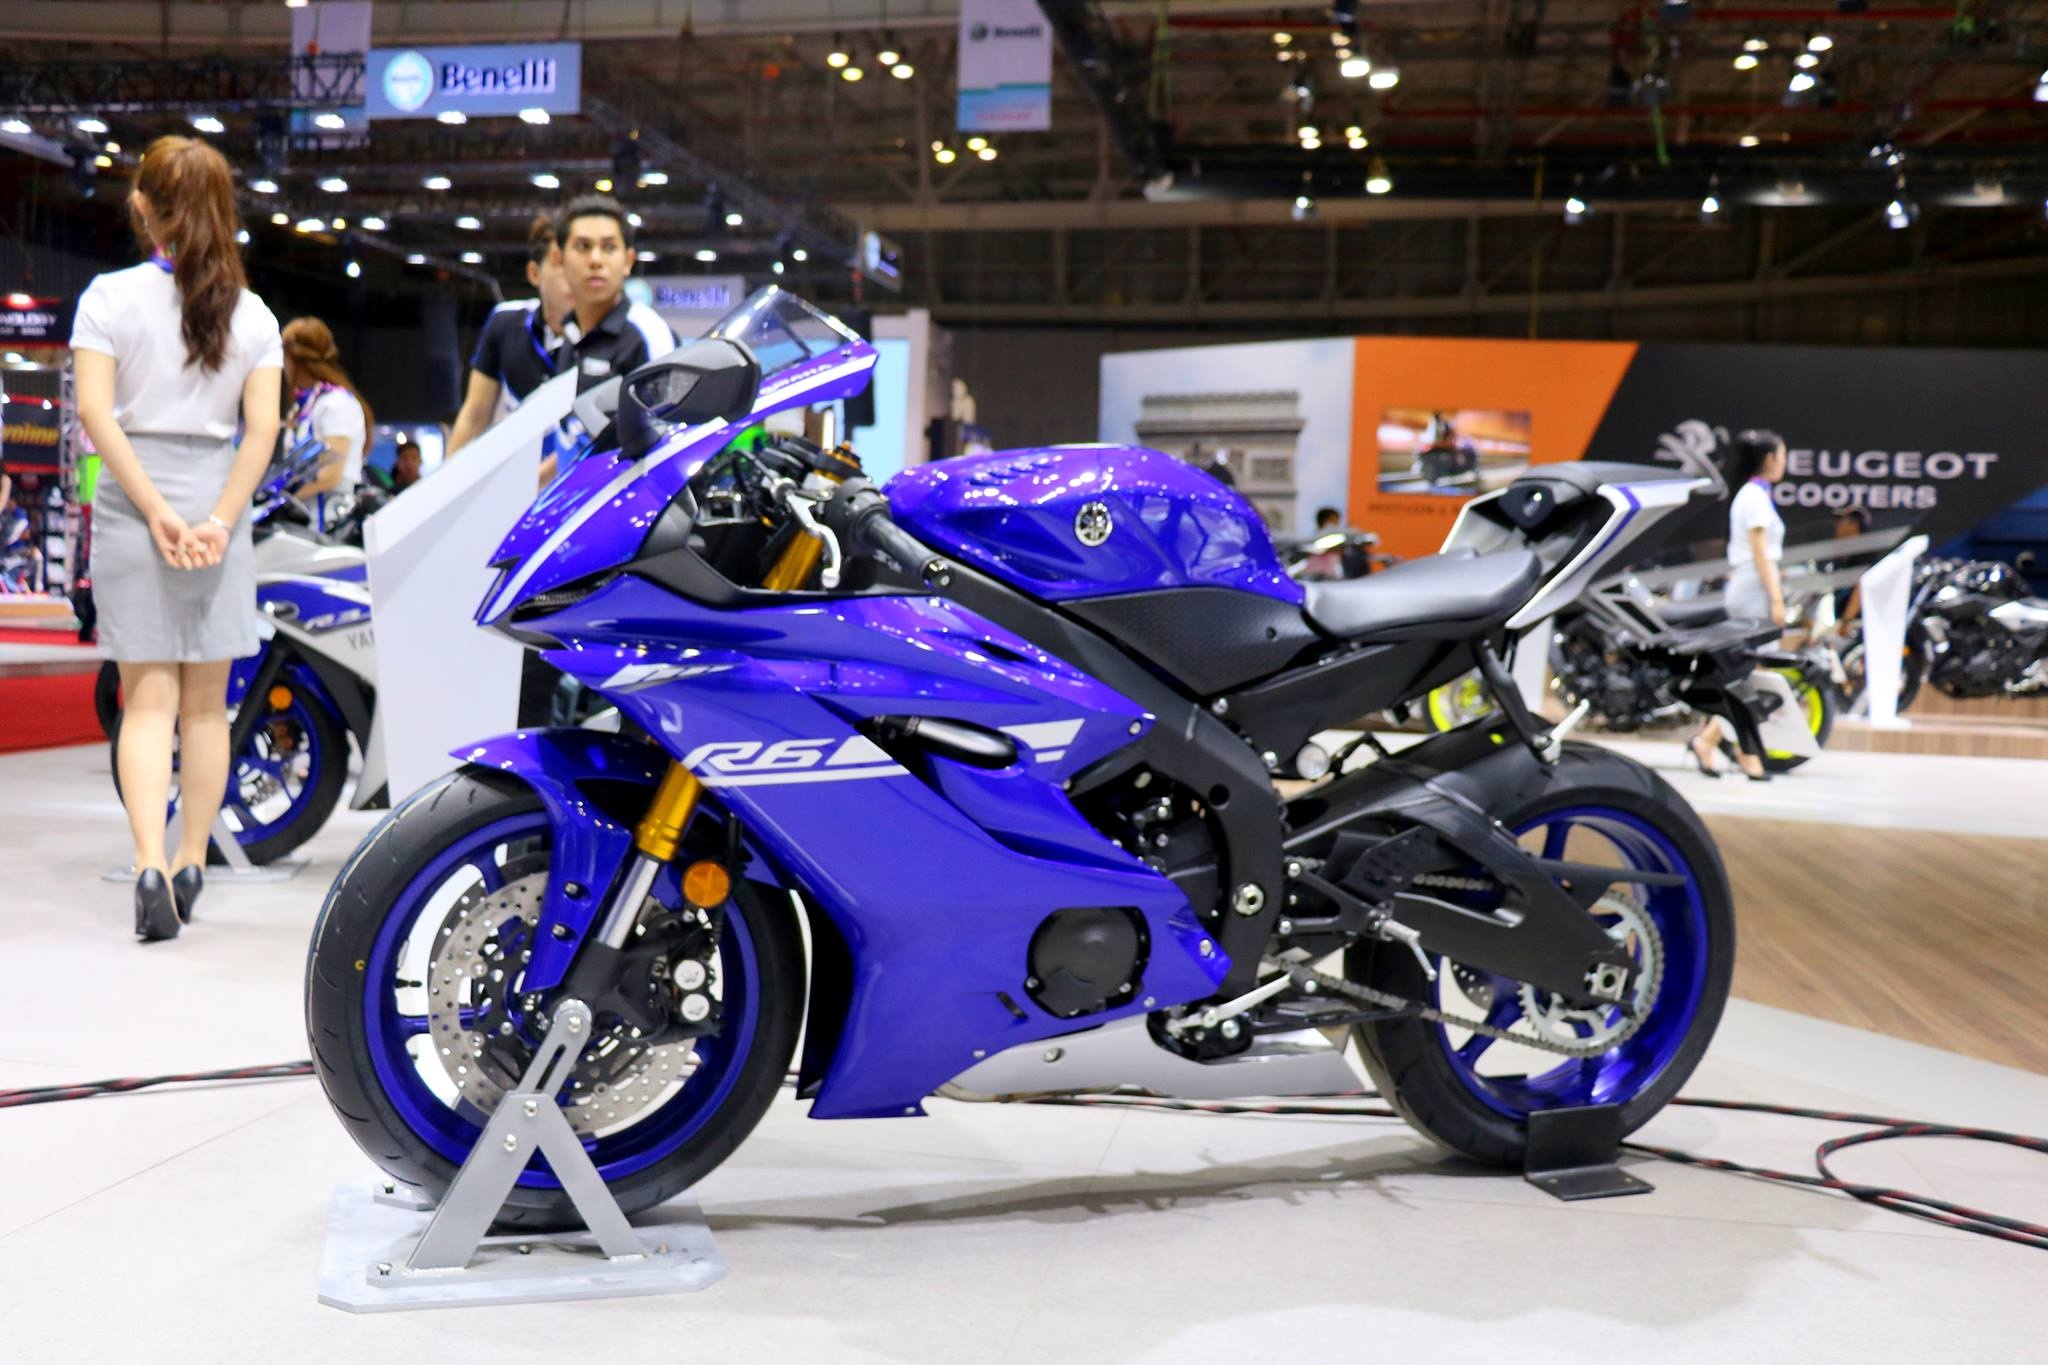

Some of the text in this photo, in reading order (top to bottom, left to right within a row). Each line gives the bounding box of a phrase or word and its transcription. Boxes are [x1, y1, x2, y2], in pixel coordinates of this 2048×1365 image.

[440, 59, 555, 95] Benelli
[1787, 450, 1998, 479] EUGEOT
[1772, 482, 1937, 508] COOTERS
[682, 738, 835, 772] R6
